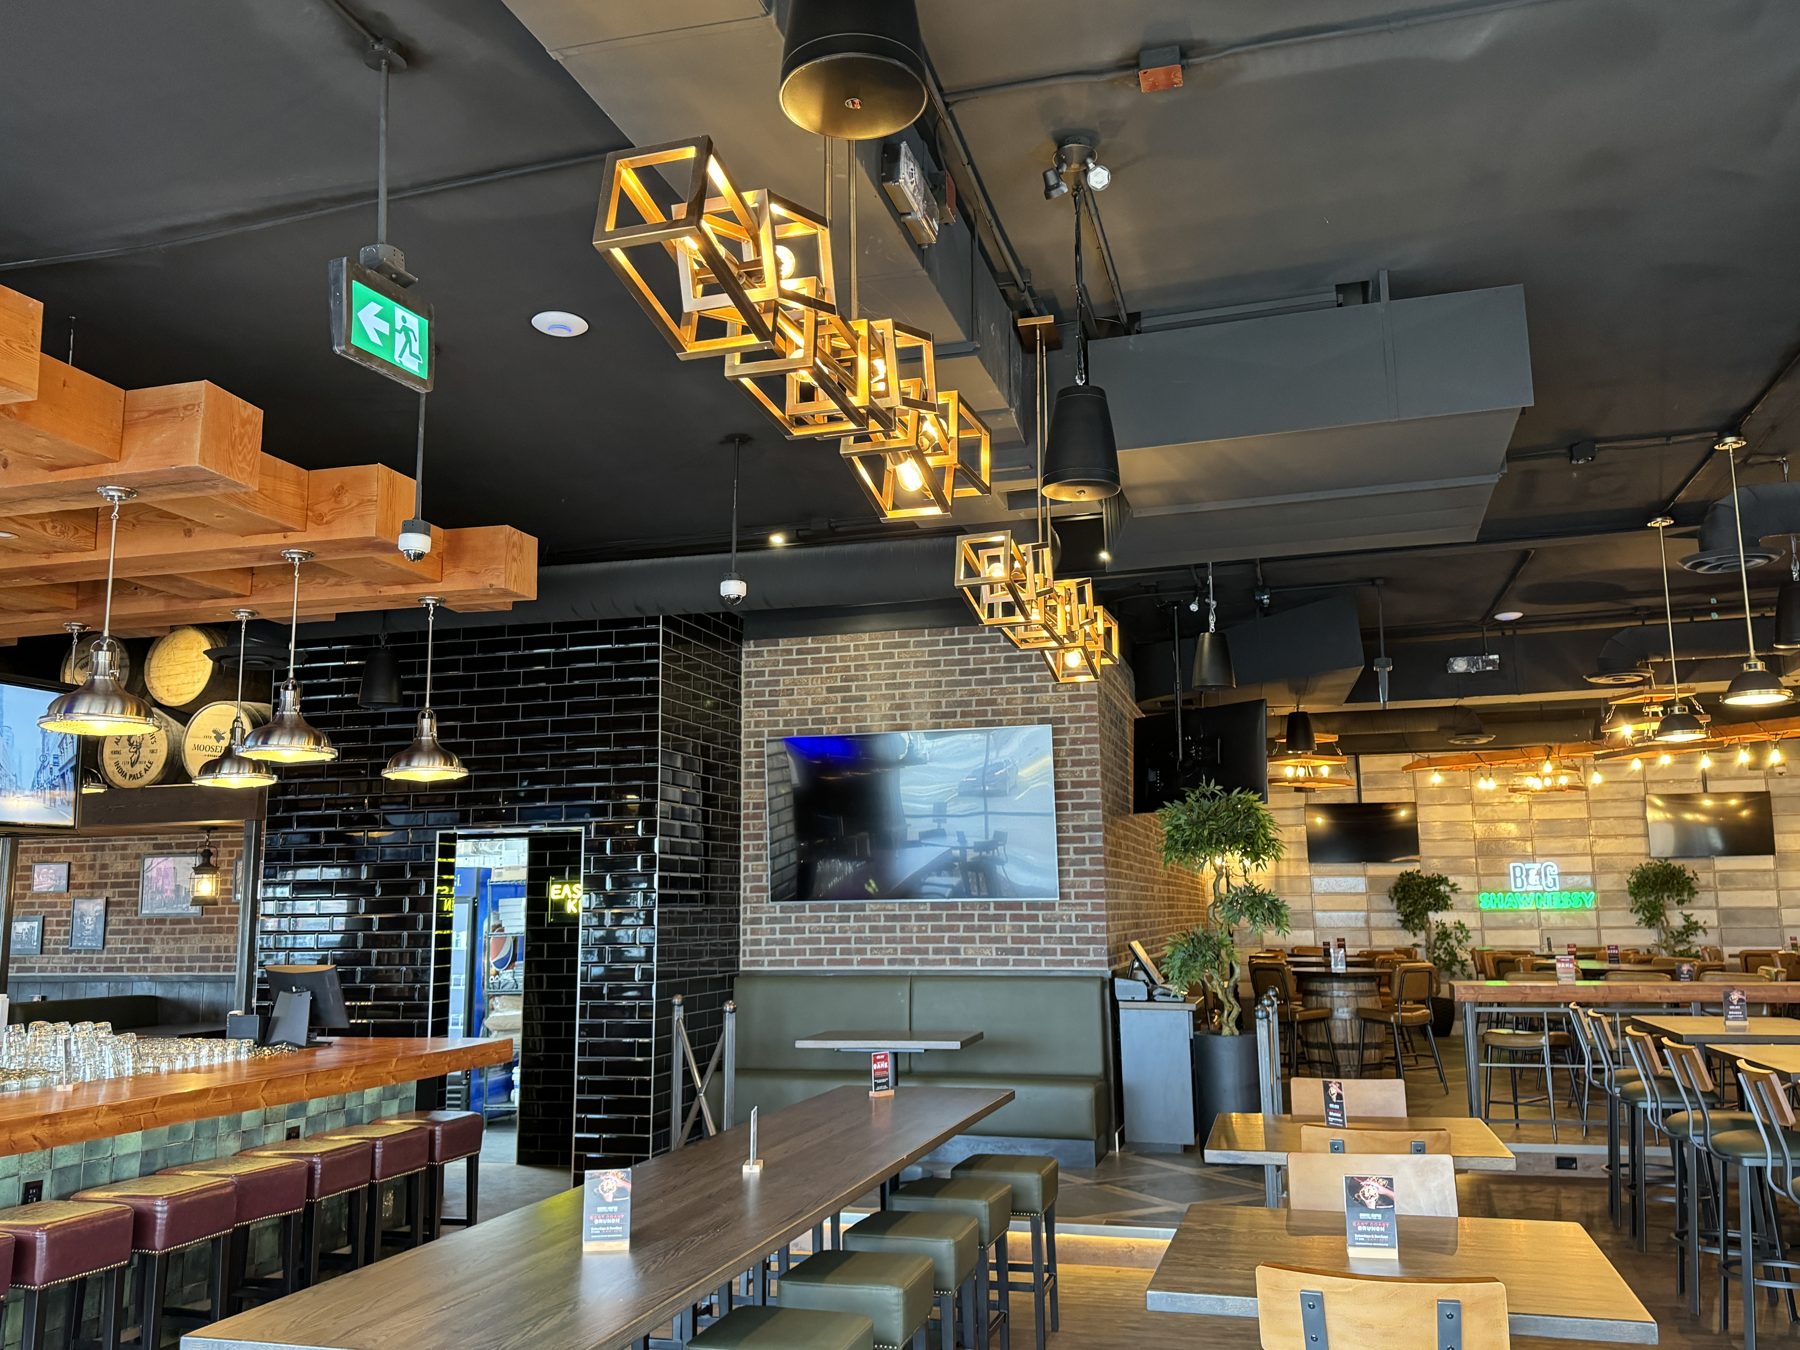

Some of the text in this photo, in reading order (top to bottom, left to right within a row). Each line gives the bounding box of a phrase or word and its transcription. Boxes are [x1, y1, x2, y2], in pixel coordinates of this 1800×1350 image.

[114, 760, 154, 781] INDIA PALE ALE
[550, 884, 583, 899] EAS
[1479, 891, 1595, 909] SHAWNESSY
